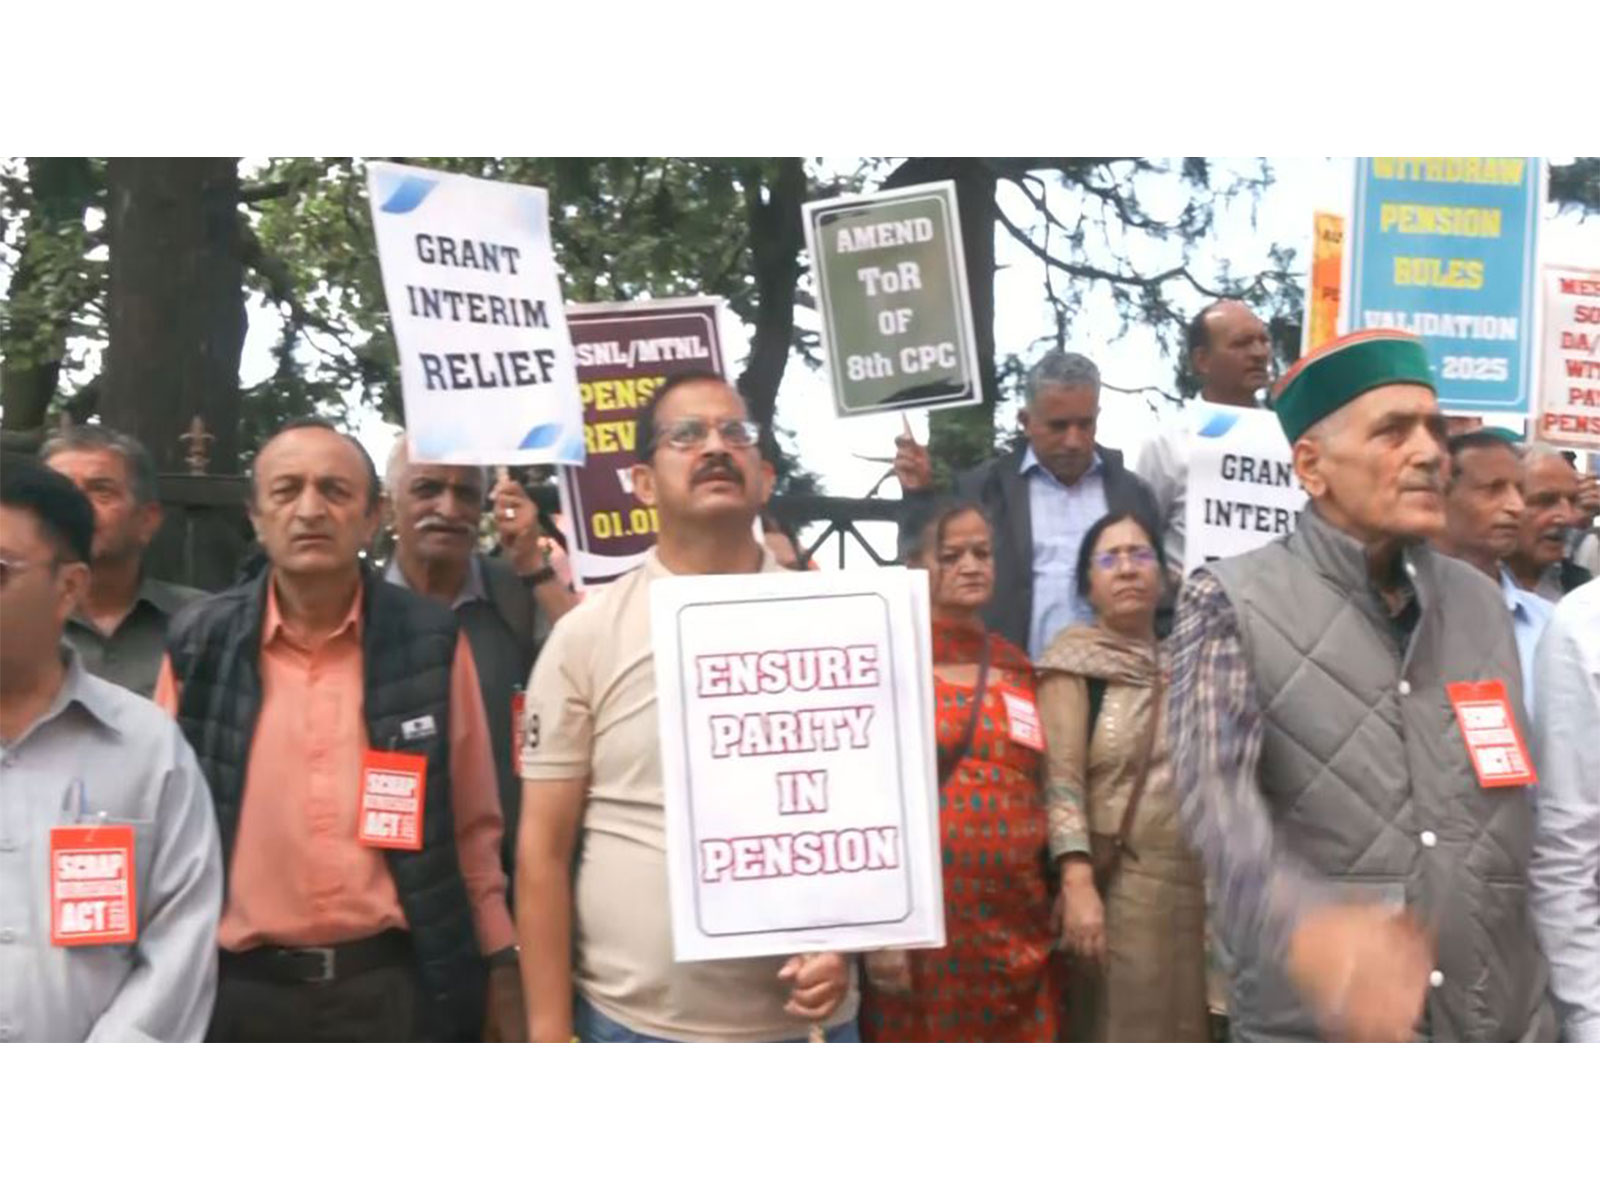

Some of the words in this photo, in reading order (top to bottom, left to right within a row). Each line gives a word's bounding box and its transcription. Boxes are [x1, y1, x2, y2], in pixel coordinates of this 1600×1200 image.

[837, 217, 934, 252] AMEND
[1380, 203, 1502, 238] PENSION
[415, 233, 520, 275] GRANT
[857, 262, 921, 296] ToR
[406, 285, 550, 329] INTERIM
[878, 308, 913, 335] OF
[1364, 310, 1518, 340] VALIDATION
[419, 349, 555, 391] RELIEF
[847, 353, 894, 381] 8th
[901, 342, 957, 374] CPC
[1441, 356, 1508, 382] 2025
[578, 376, 666, 412] PENS
[1221, 453, 1304, 490] GRAN
[696, 645, 880, 698] ENSURE
[709, 705, 876, 759] PARITY
[776, 769, 828, 815] IN
[701, 826, 898, 883] PENSION
[61, 900, 106, 932] ACT
